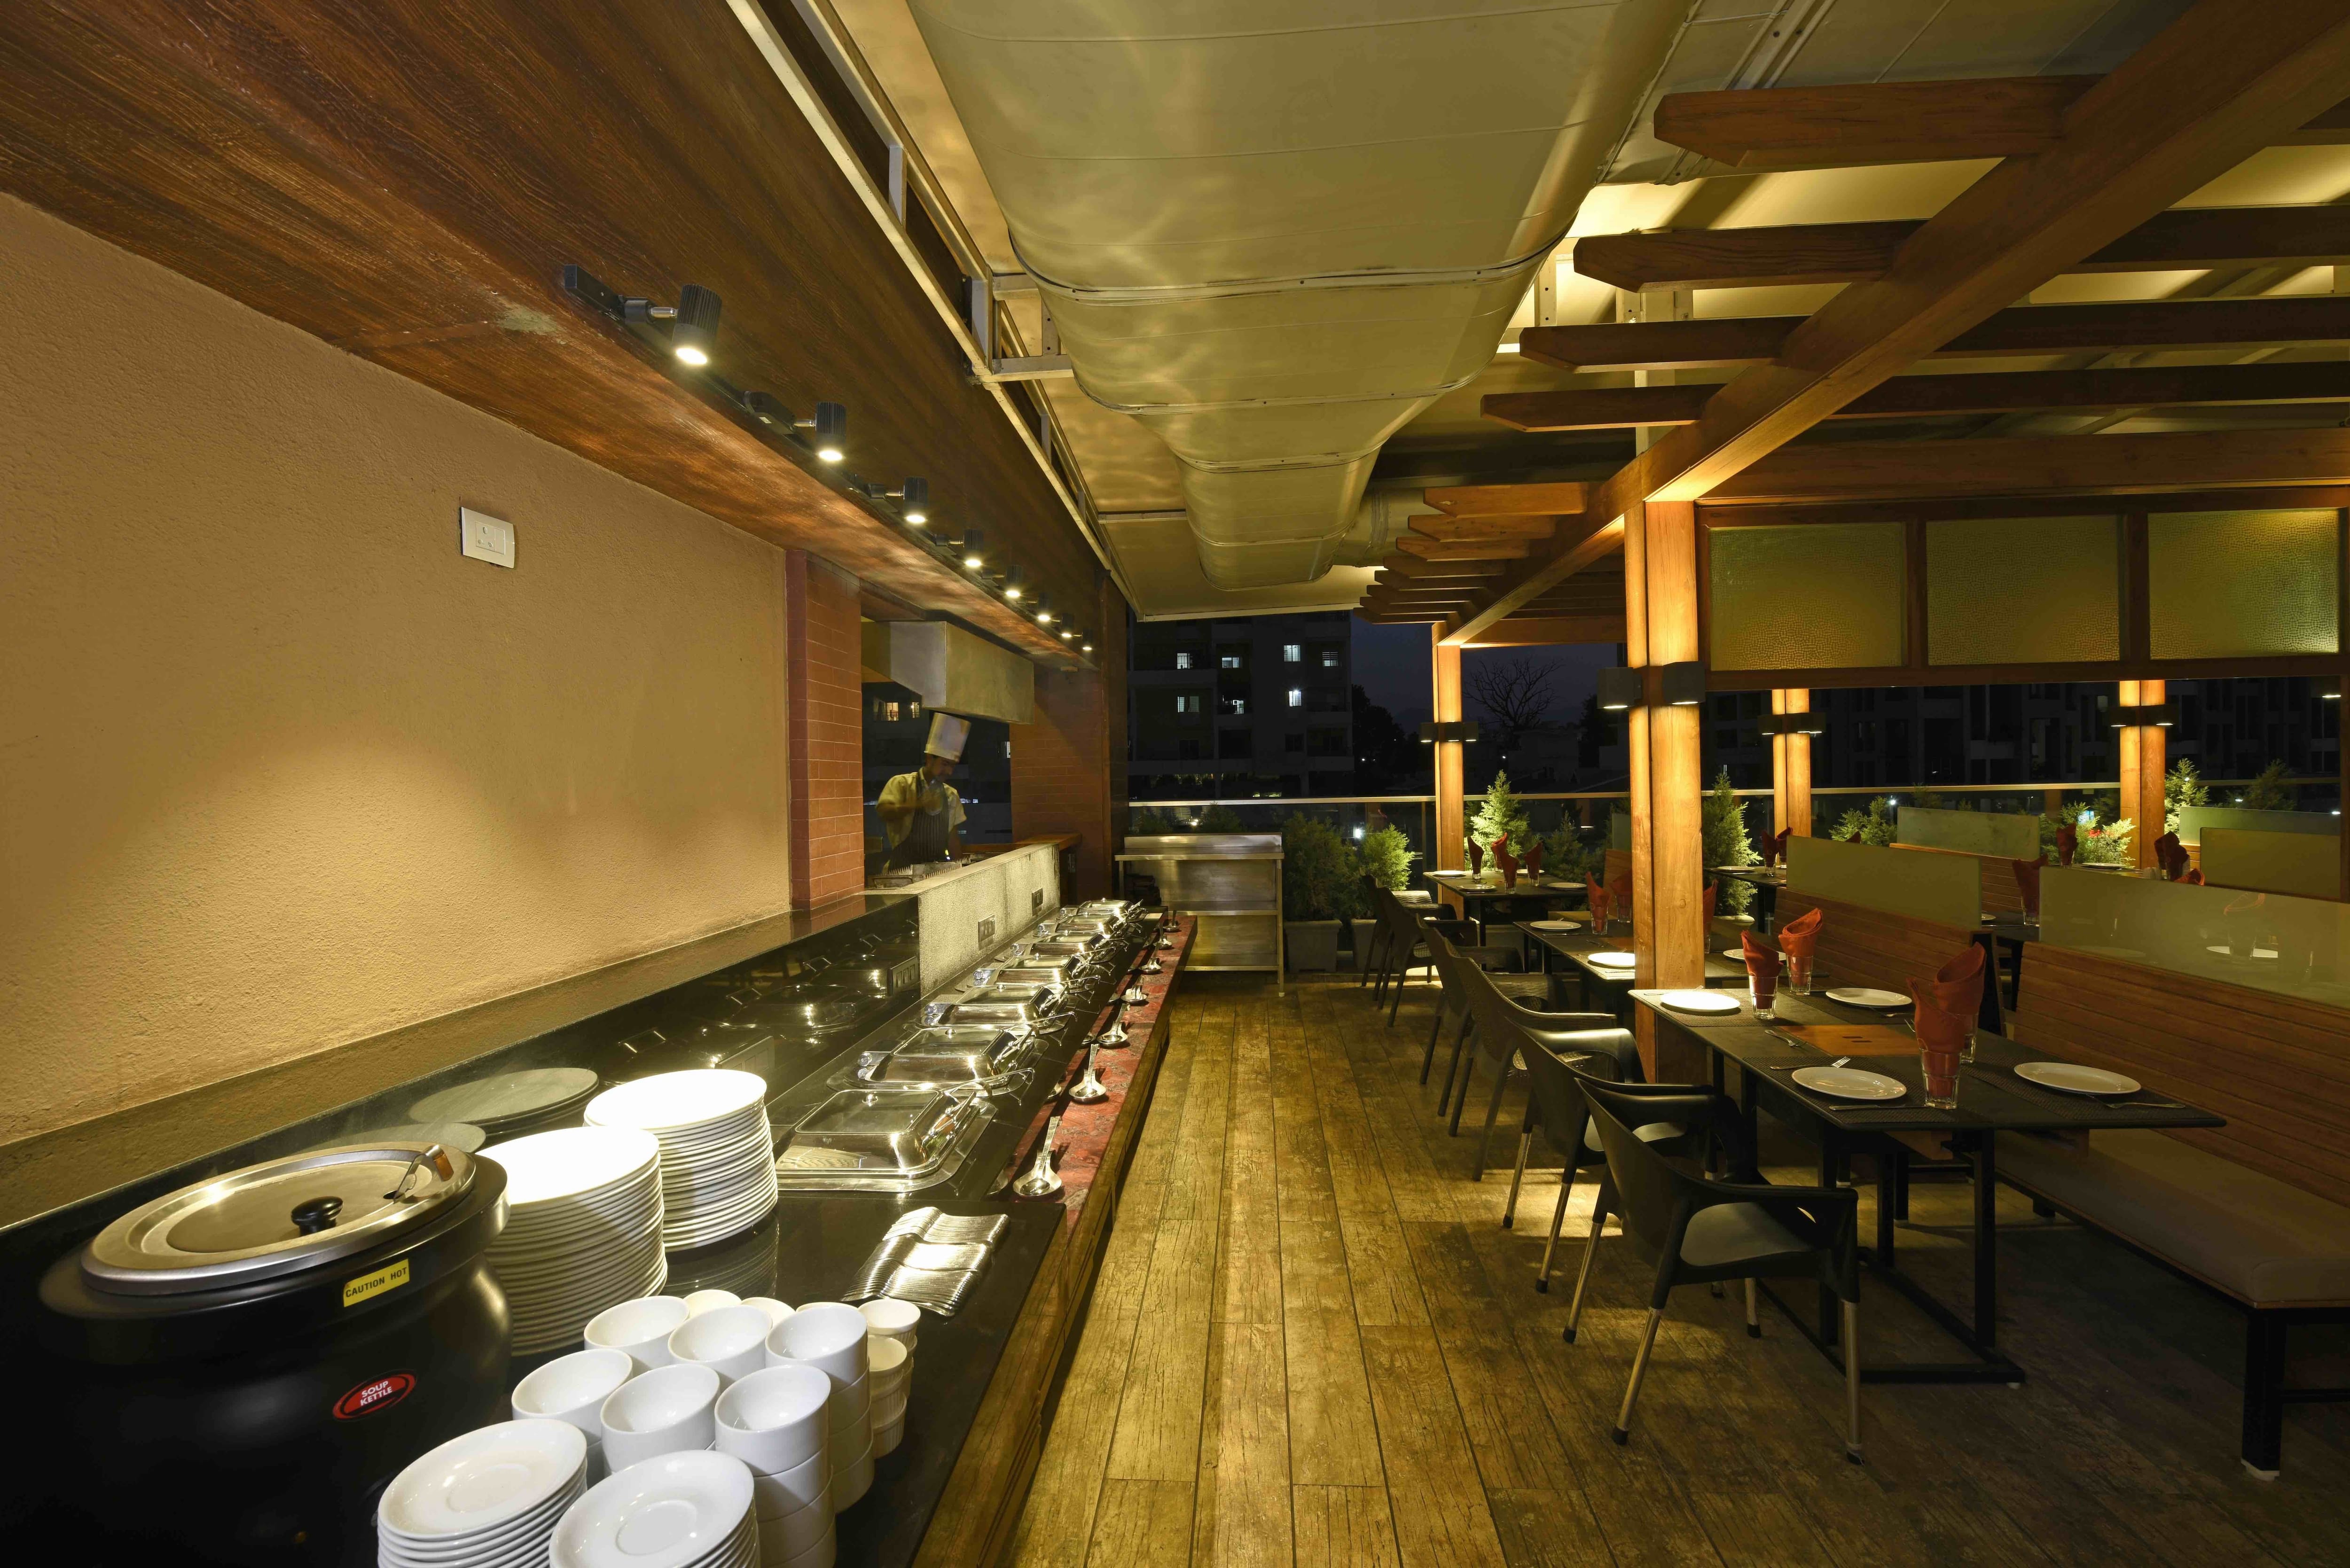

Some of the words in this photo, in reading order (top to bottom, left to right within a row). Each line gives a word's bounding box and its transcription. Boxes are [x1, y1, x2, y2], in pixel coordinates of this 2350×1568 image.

[345, 1276, 384, 1297] CAUTION
[391, 1267, 407, 1280] HOT
[360, 1386, 392, 1406] KETTLE
[361, 1381, 388, 1397] SOUP
